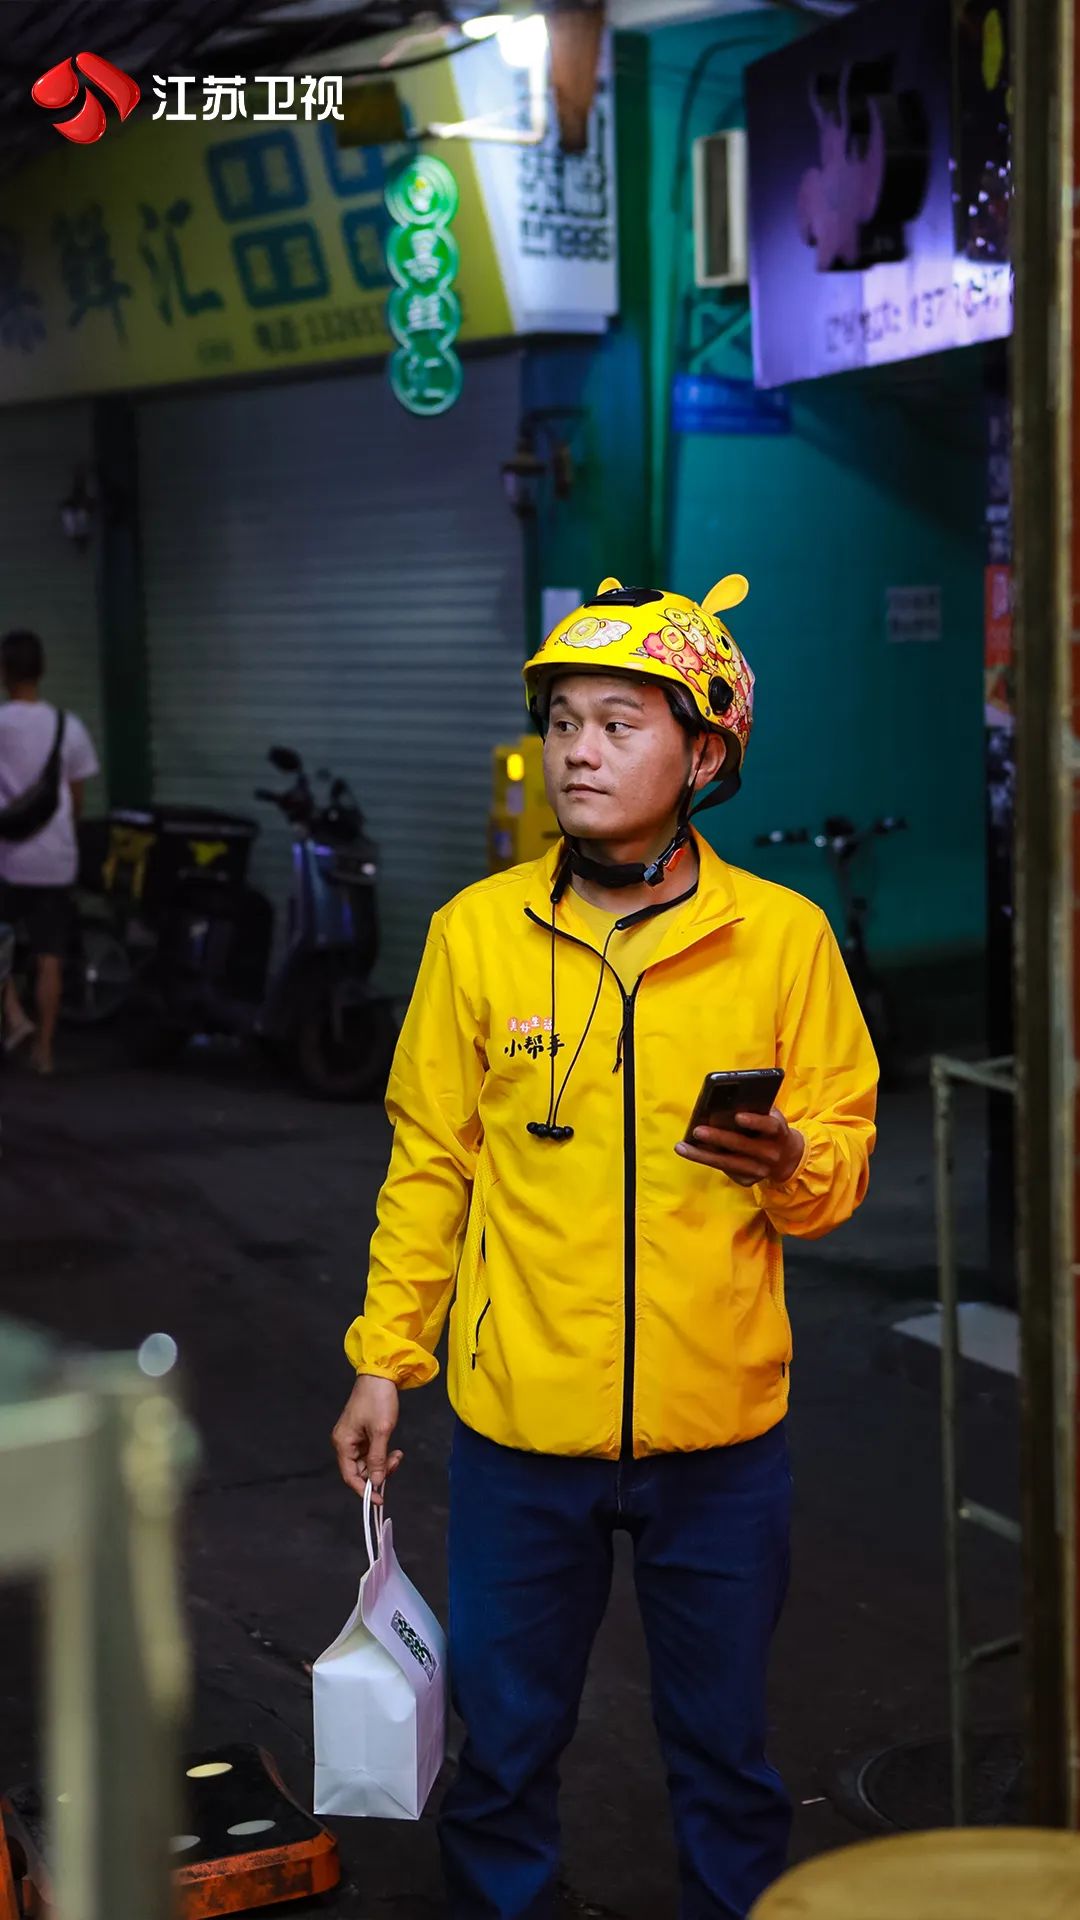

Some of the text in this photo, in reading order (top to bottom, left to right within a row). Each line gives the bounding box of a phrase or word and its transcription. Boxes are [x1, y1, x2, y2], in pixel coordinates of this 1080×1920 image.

[508, 1016, 554, 1033] 美好生活
[503, 1033, 566, 1060] 小帮手
